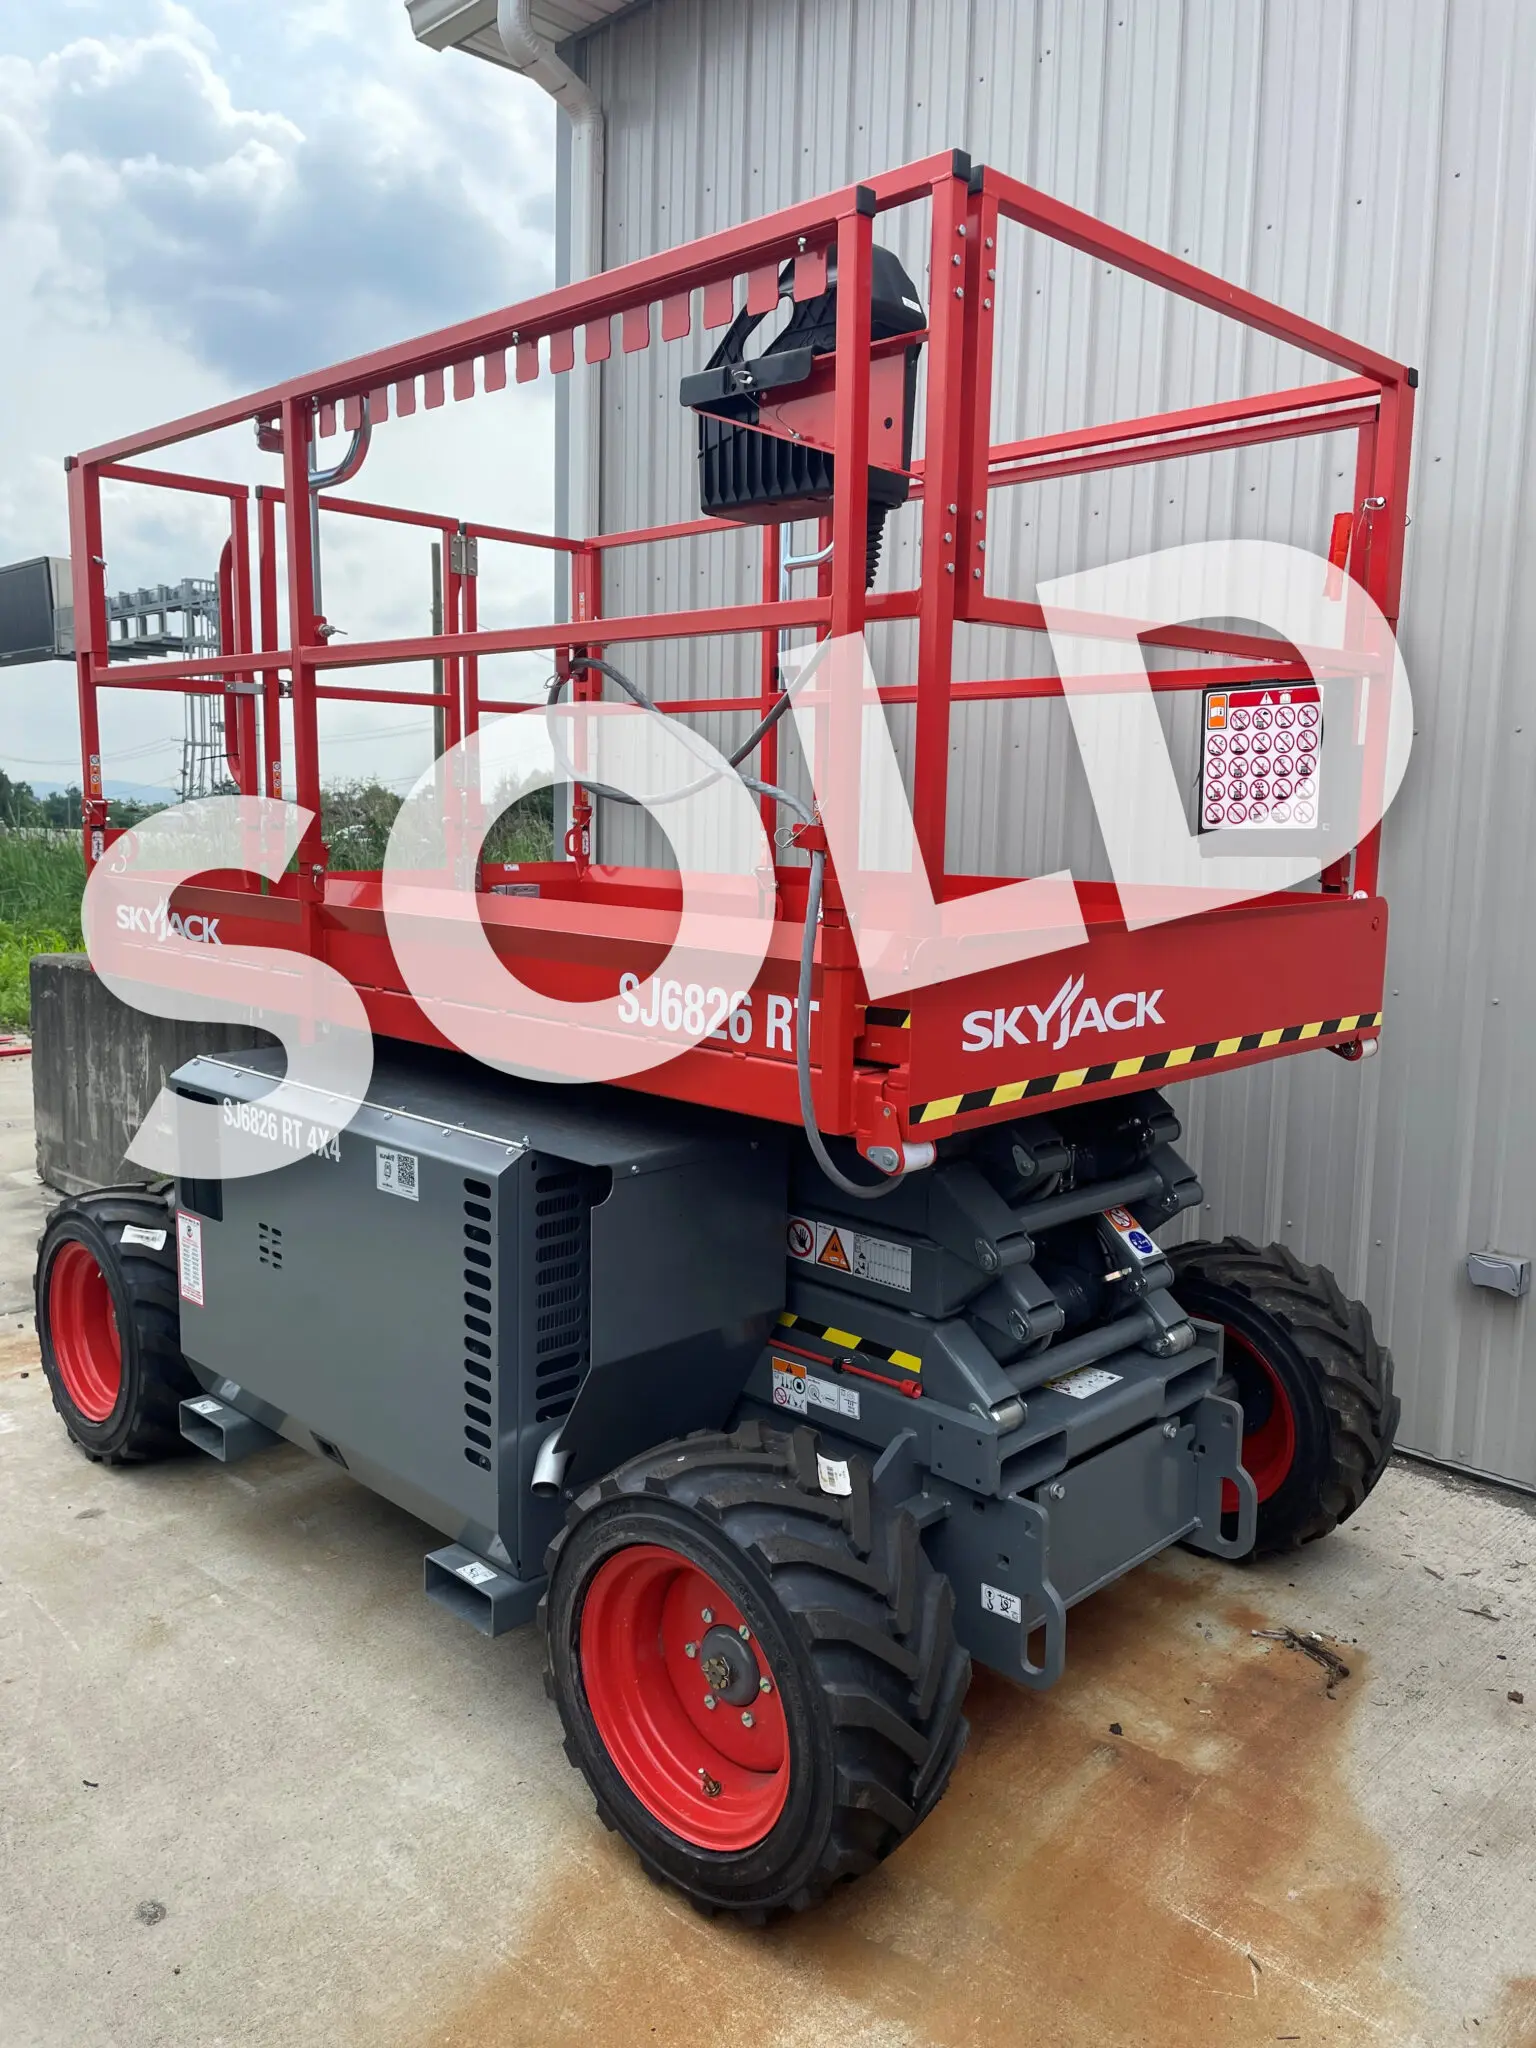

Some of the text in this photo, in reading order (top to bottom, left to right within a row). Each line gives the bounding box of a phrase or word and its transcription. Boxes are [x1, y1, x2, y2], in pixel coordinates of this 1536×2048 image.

[116, 895, 223, 946] SKYJACK
[618, 972, 820, 1052] SJ6826 RT
[961, 973, 1166, 1052] SKYJACK
[223, 1097, 342, 1163] SJ6826 RT 4X4
